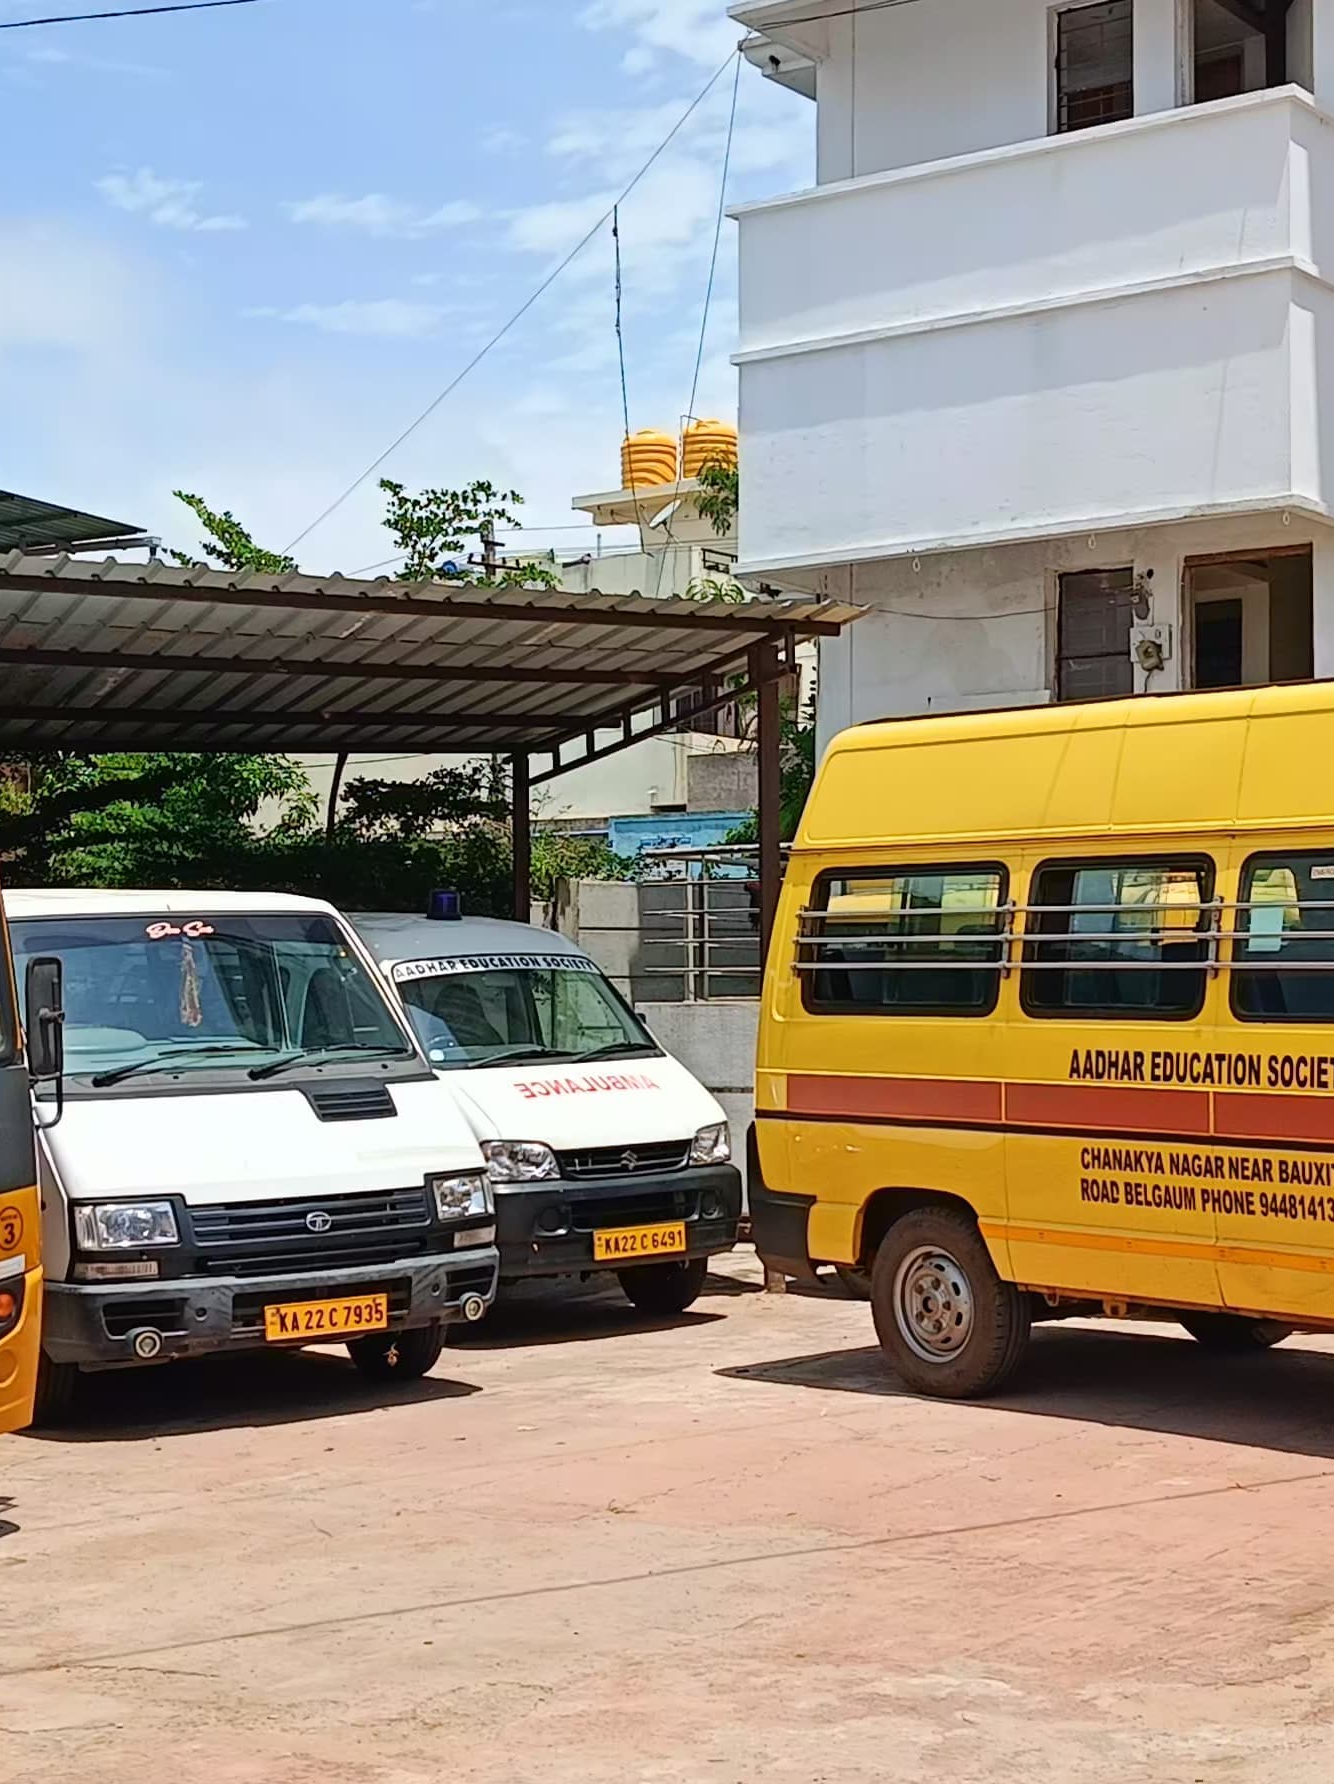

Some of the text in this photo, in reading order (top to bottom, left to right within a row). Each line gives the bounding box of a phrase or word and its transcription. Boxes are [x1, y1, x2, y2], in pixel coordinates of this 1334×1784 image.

[395, 955, 594, 979] AADHAR EDUCATION SOCIETY
[1068, 1049, 1145, 1082] AADHAR
[1150, 1051, 1262, 1086] EDUCATION
[1080, 1146, 1165, 1175] CHANAKYA
[1169, 1152, 1225, 1180] NAGAR
[1228, 1156, 1274, 1183] NEAR
[1080, 1177, 1119, 1204] ROAD
[1123, 1181, 1197, 1211] BELGAUM
[1201, 1187, 1256, 1216] PHONE
[4, 1222, 15, 1244] 3
[652, 1229, 683, 1249] 6491
[343, 1302, 384, 1326] 7935
